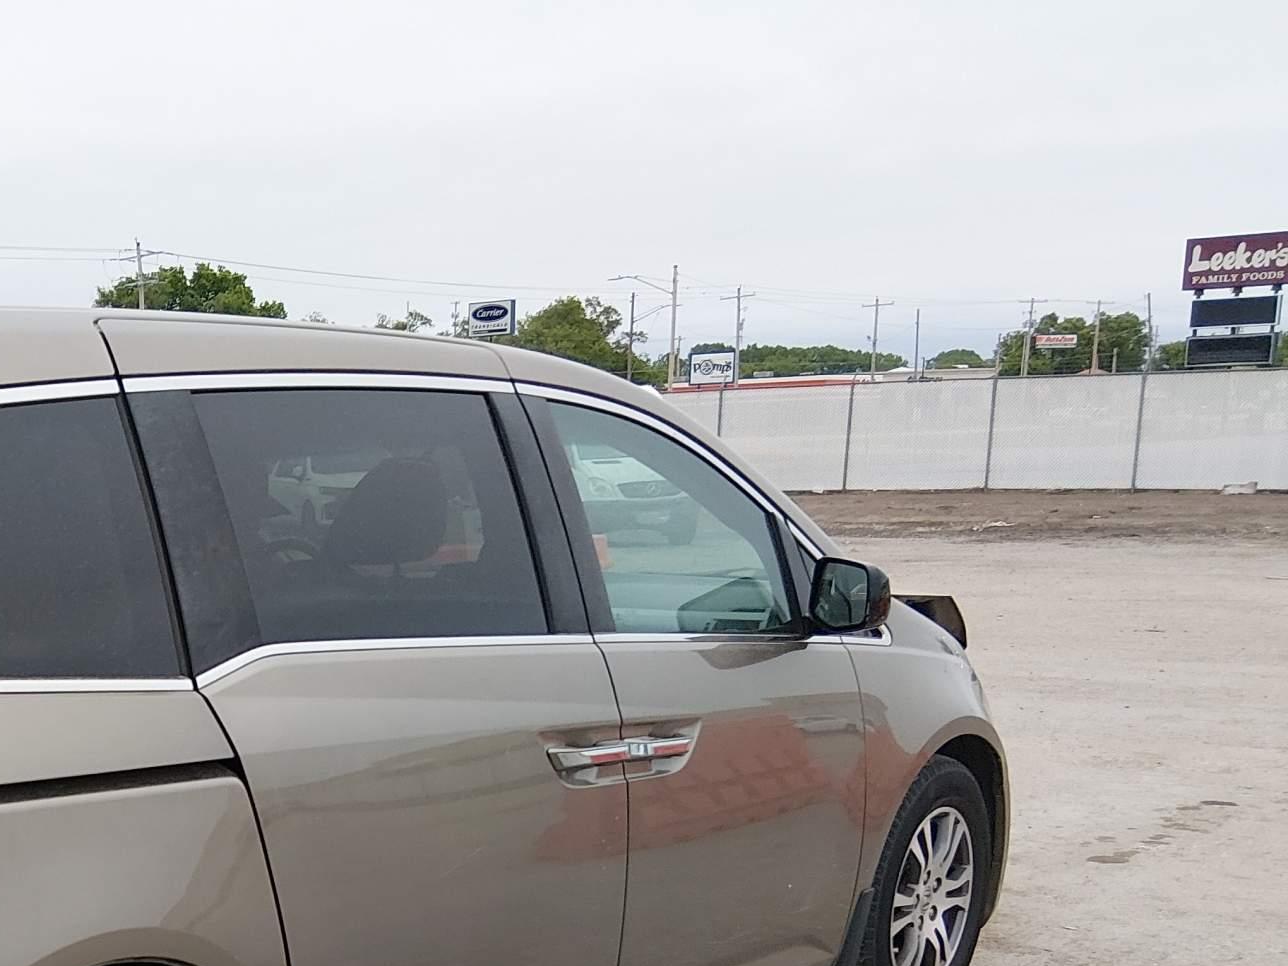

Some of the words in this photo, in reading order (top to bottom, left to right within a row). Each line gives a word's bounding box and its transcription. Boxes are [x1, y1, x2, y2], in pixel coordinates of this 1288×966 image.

[1188, 242, 1288, 273] Leeker's
[1191, 273, 1240, 285] FAMILY
[1241, 270, 1285, 282] FOODS
[476, 308, 505, 318] Carrier
